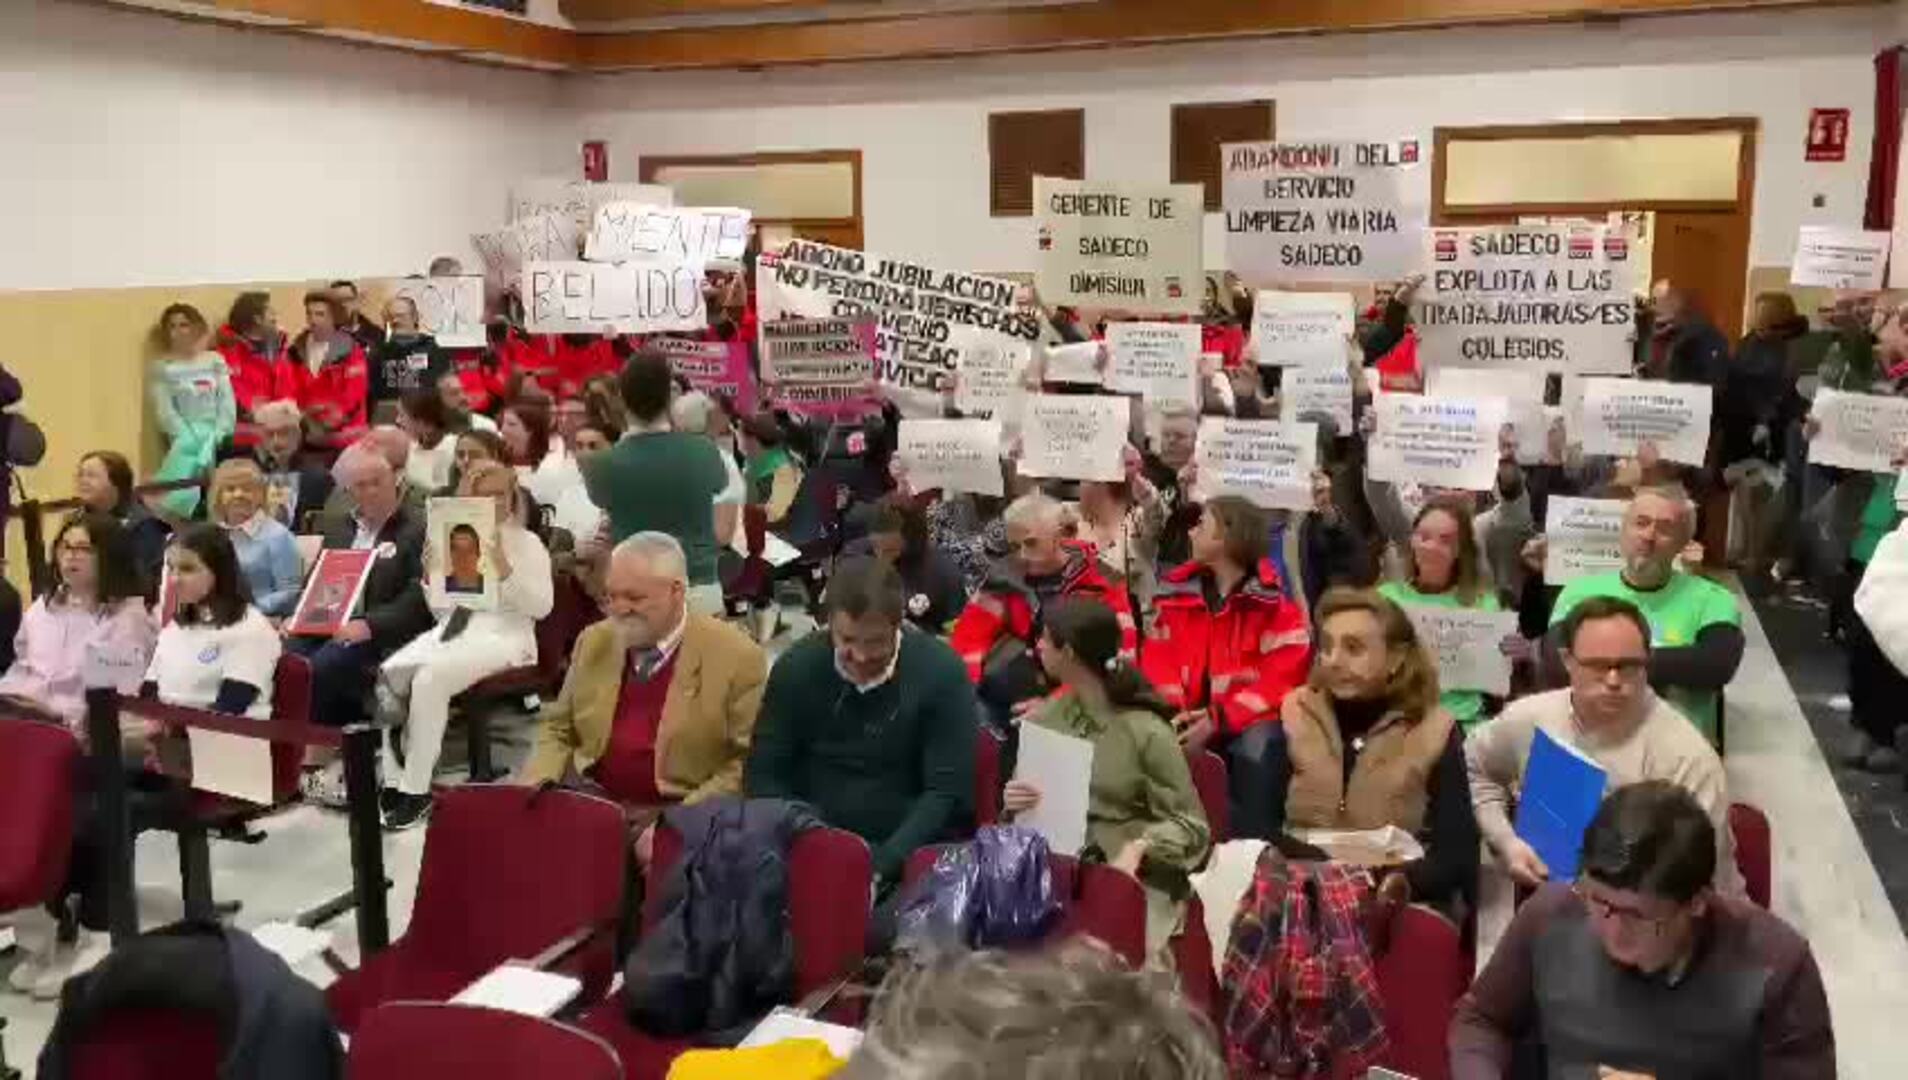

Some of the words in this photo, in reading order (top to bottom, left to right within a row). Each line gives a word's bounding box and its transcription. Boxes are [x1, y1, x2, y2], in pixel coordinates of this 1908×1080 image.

[1355, 143, 1399, 167] DEL
[1051, 193, 1131, 217] GERENTE
[1149, 197, 1175, 219] DE
[1226, 209, 1315, 233] LIMPIEZA
[1326, 209, 1398, 235] VIARIA
[1079, 235, 1149, 258] SADECO
[1281, 243, 1363, 266] SADECO
[1470, 233, 1560, 256] SADECO
[775, 260, 807, 289] NO
[869, 259, 1016, 308] JUBILACION
[1435, 269, 1535, 292] EXPLOTA
[1545, 269, 1558, 291] A
[1567, 268, 1613, 291] LAS
[532, 265, 699, 324] BELIDO
[1423, 301, 1631, 326] TRABAJADORAS/ES
